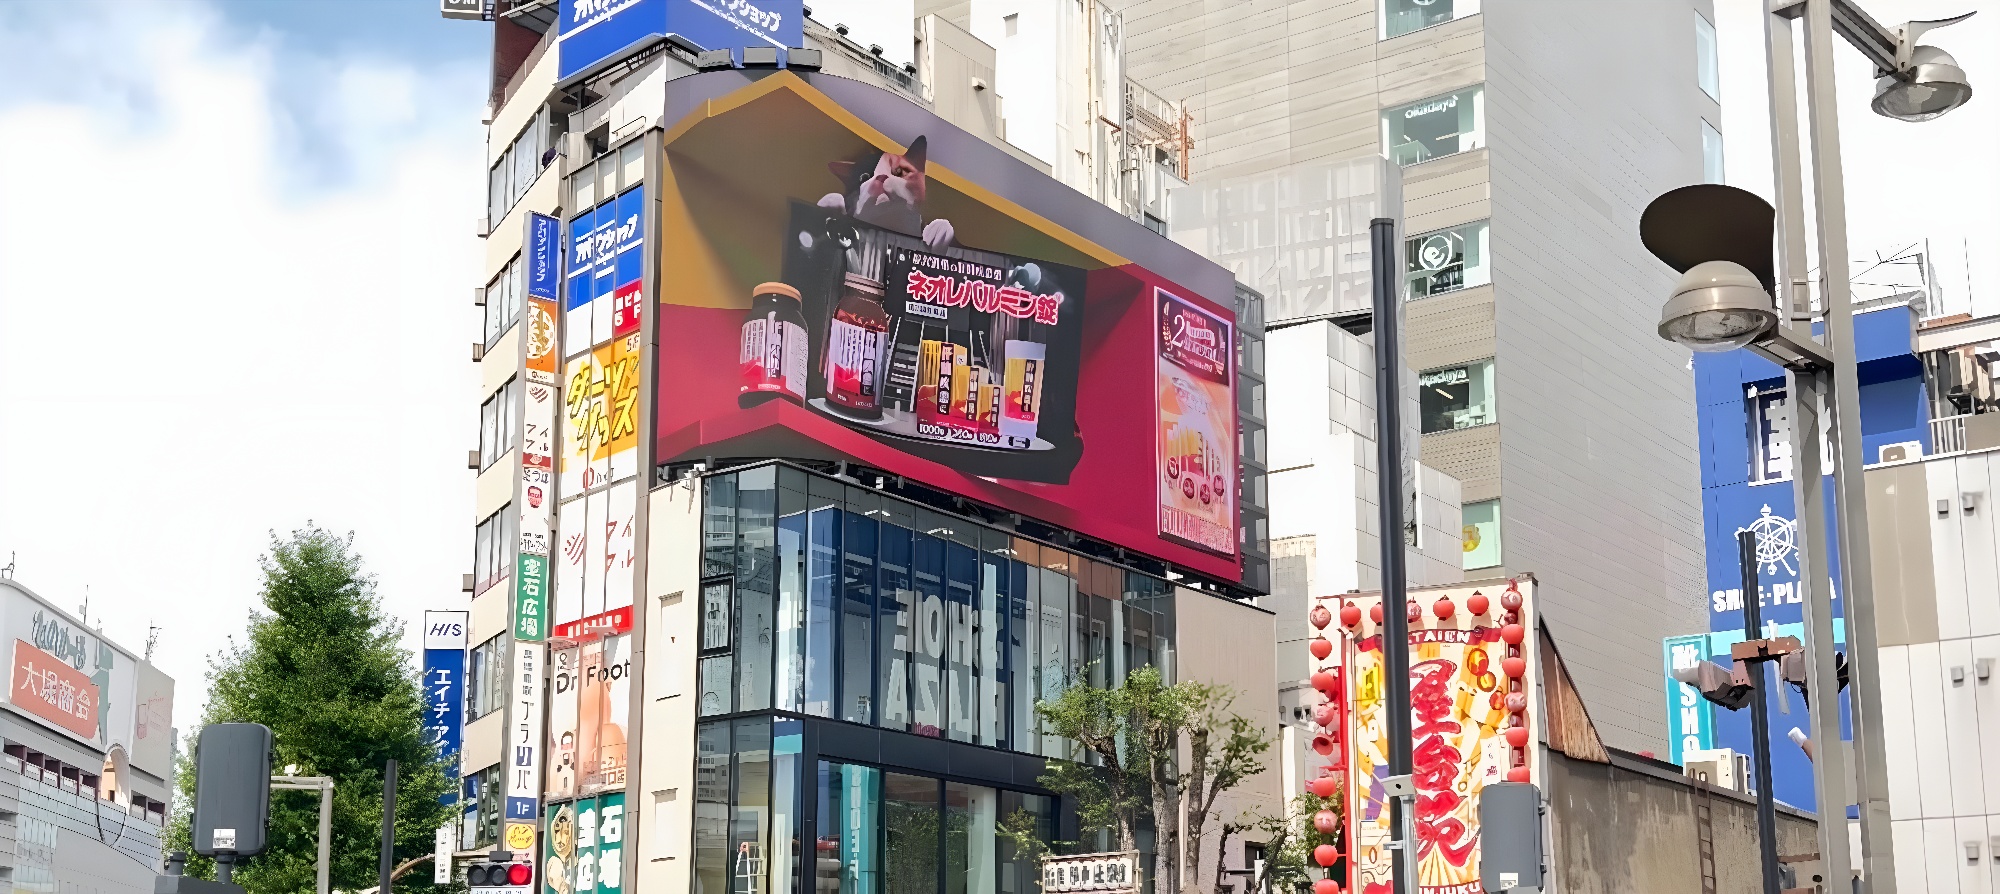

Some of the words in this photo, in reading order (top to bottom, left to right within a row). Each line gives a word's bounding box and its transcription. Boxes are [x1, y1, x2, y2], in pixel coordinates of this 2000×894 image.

[429, 622, 463, 637] HIS
[1409, 630, 1470, 645] TAIEN
[556, 671, 578, 694] Dr
[587, 658, 631, 688] Foot
[516, 701, 535, 790] ブラリバ
[516, 801, 530, 815] 1F
